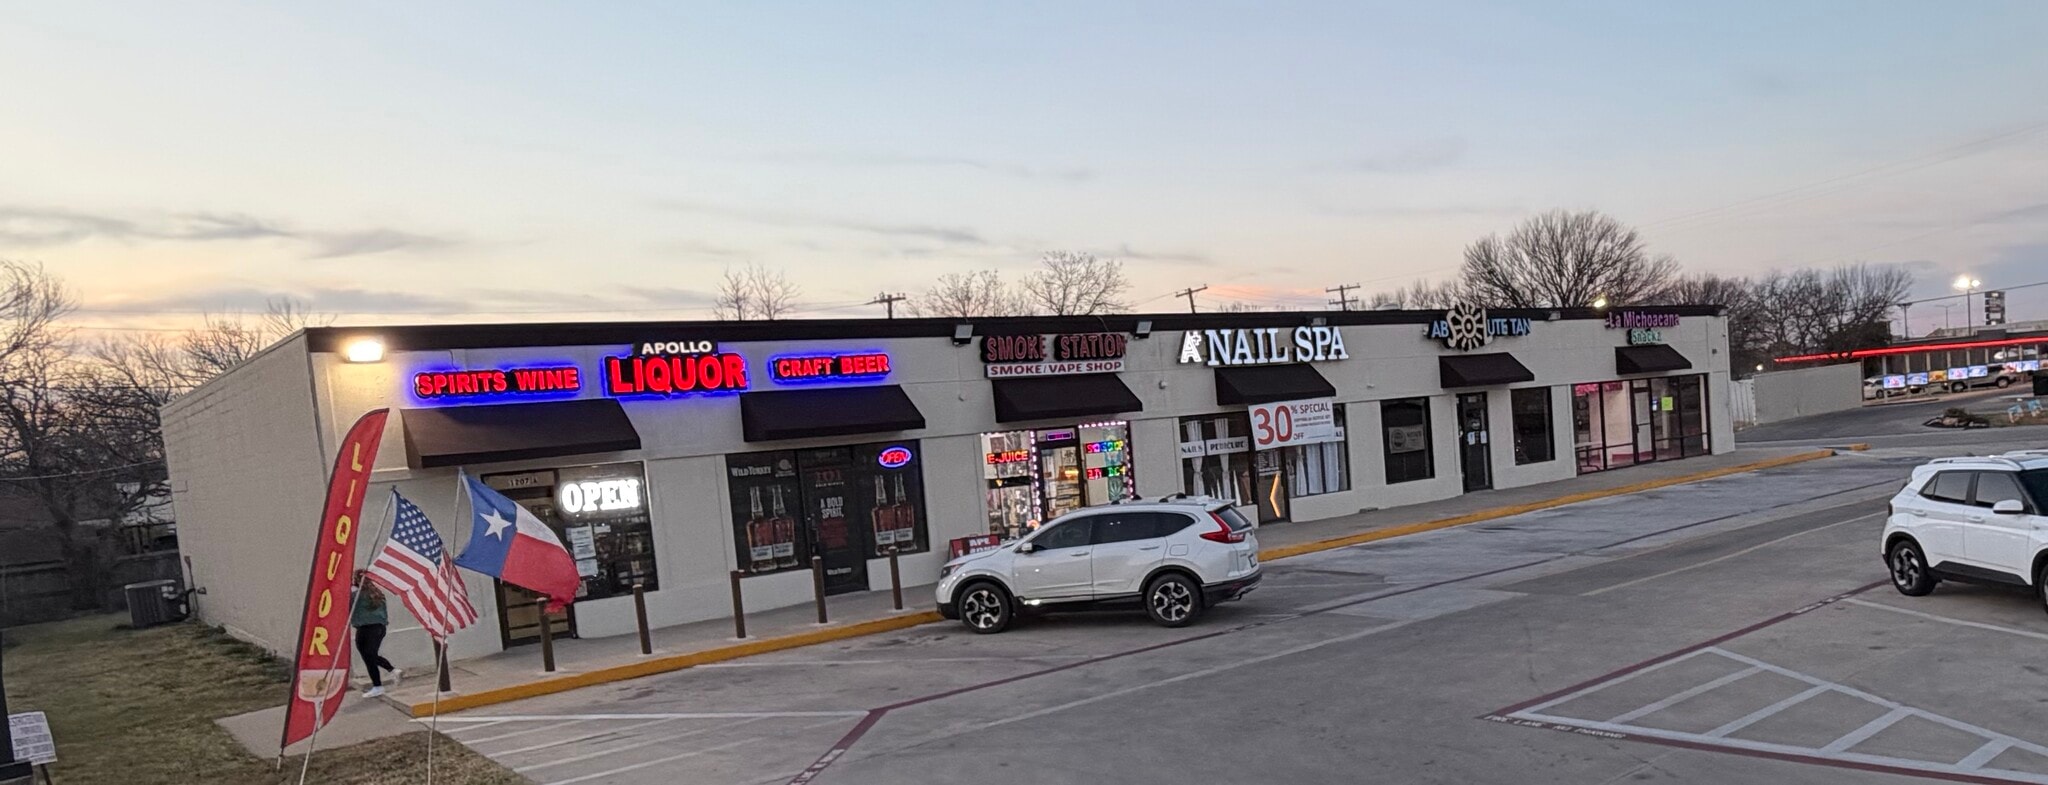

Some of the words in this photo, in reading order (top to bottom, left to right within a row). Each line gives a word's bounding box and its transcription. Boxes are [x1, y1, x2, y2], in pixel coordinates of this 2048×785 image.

[1509, 317, 1532, 336] TAN
[1608, 312, 1621, 328] La
[1623, 311, 1680, 328] Michoacana
[641, 340, 712, 355] APOLLO
[987, 335, 1047, 361] SMOKE
[1060, 333, 1127, 359] STATION
[1205, 328, 1289, 366] NAIL
[1294, 326, 1349, 362] SPA
[611, 355, 747, 394] LIQUOR
[778, 358, 833, 378] CRAFT
[842, 354, 889, 376] BEER
[1086, 360, 1122, 373] SHOP
[418, 373, 507, 396] SPIRITS
[515, 369, 579, 391] WINE
[1253, 405, 1293, 446] 30
[1299, 402, 1331, 415] SPECIAL
[1293, 432, 1305, 441] OFF
[881, 452, 908, 464] OPEN
[987, 451, 1029, 464] E-JUICE
[509, 477, 529, 487] 1207
[561, 479, 640, 513] OPEN
[308, 441, 363, 656] LIQUOR
